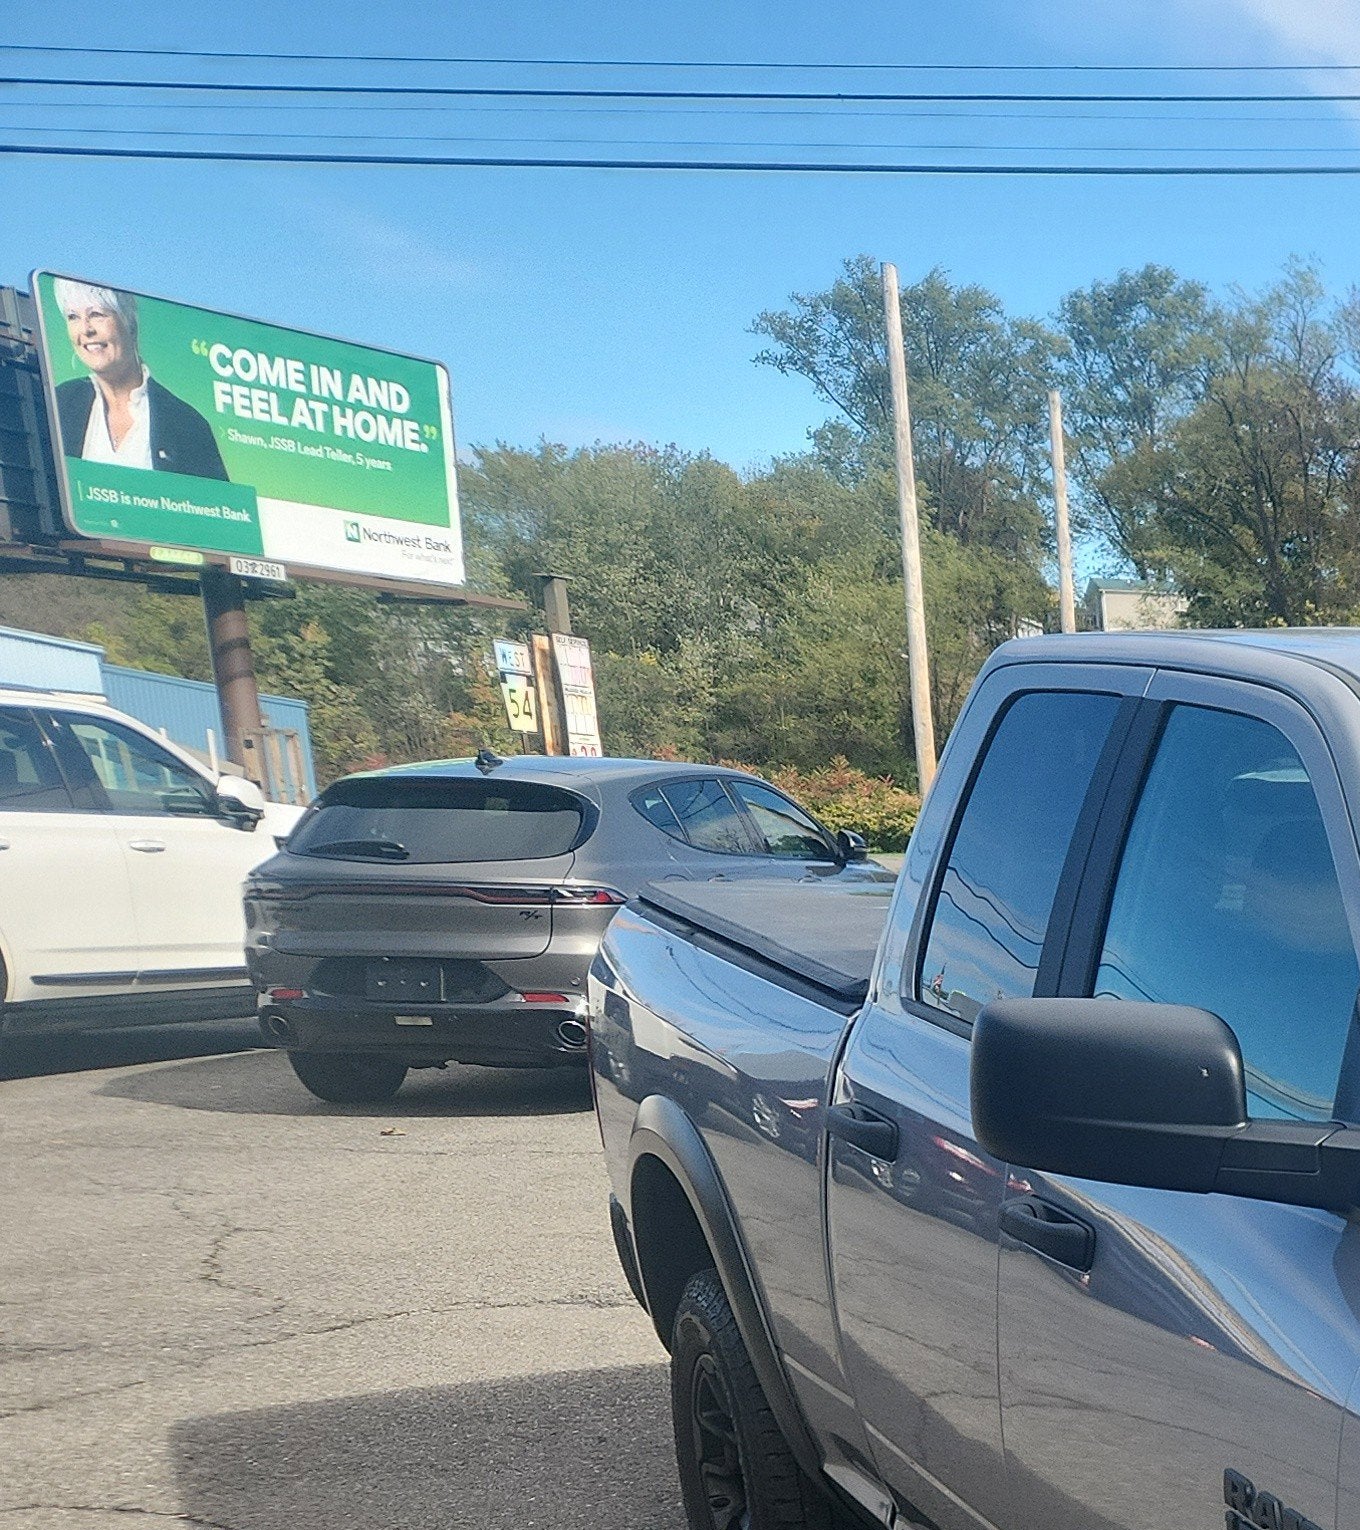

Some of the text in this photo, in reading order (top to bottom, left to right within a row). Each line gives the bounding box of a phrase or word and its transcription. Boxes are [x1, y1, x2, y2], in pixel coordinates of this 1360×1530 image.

[213, 380, 289, 426] FEEL
[290, 397, 328, 433] AT
[310, 364, 343, 401] IN
[347, 373, 411, 414] AND
[228, 428, 393, 471] Shawn, JSSB Lead Teller, 5 years
[86, 487, 253, 523] JSSB is now Northwest Bank
[362, 527, 452, 553] Northwest Bank
[500, 648, 525, 668] WEST
[508, 688, 533, 720] 54
